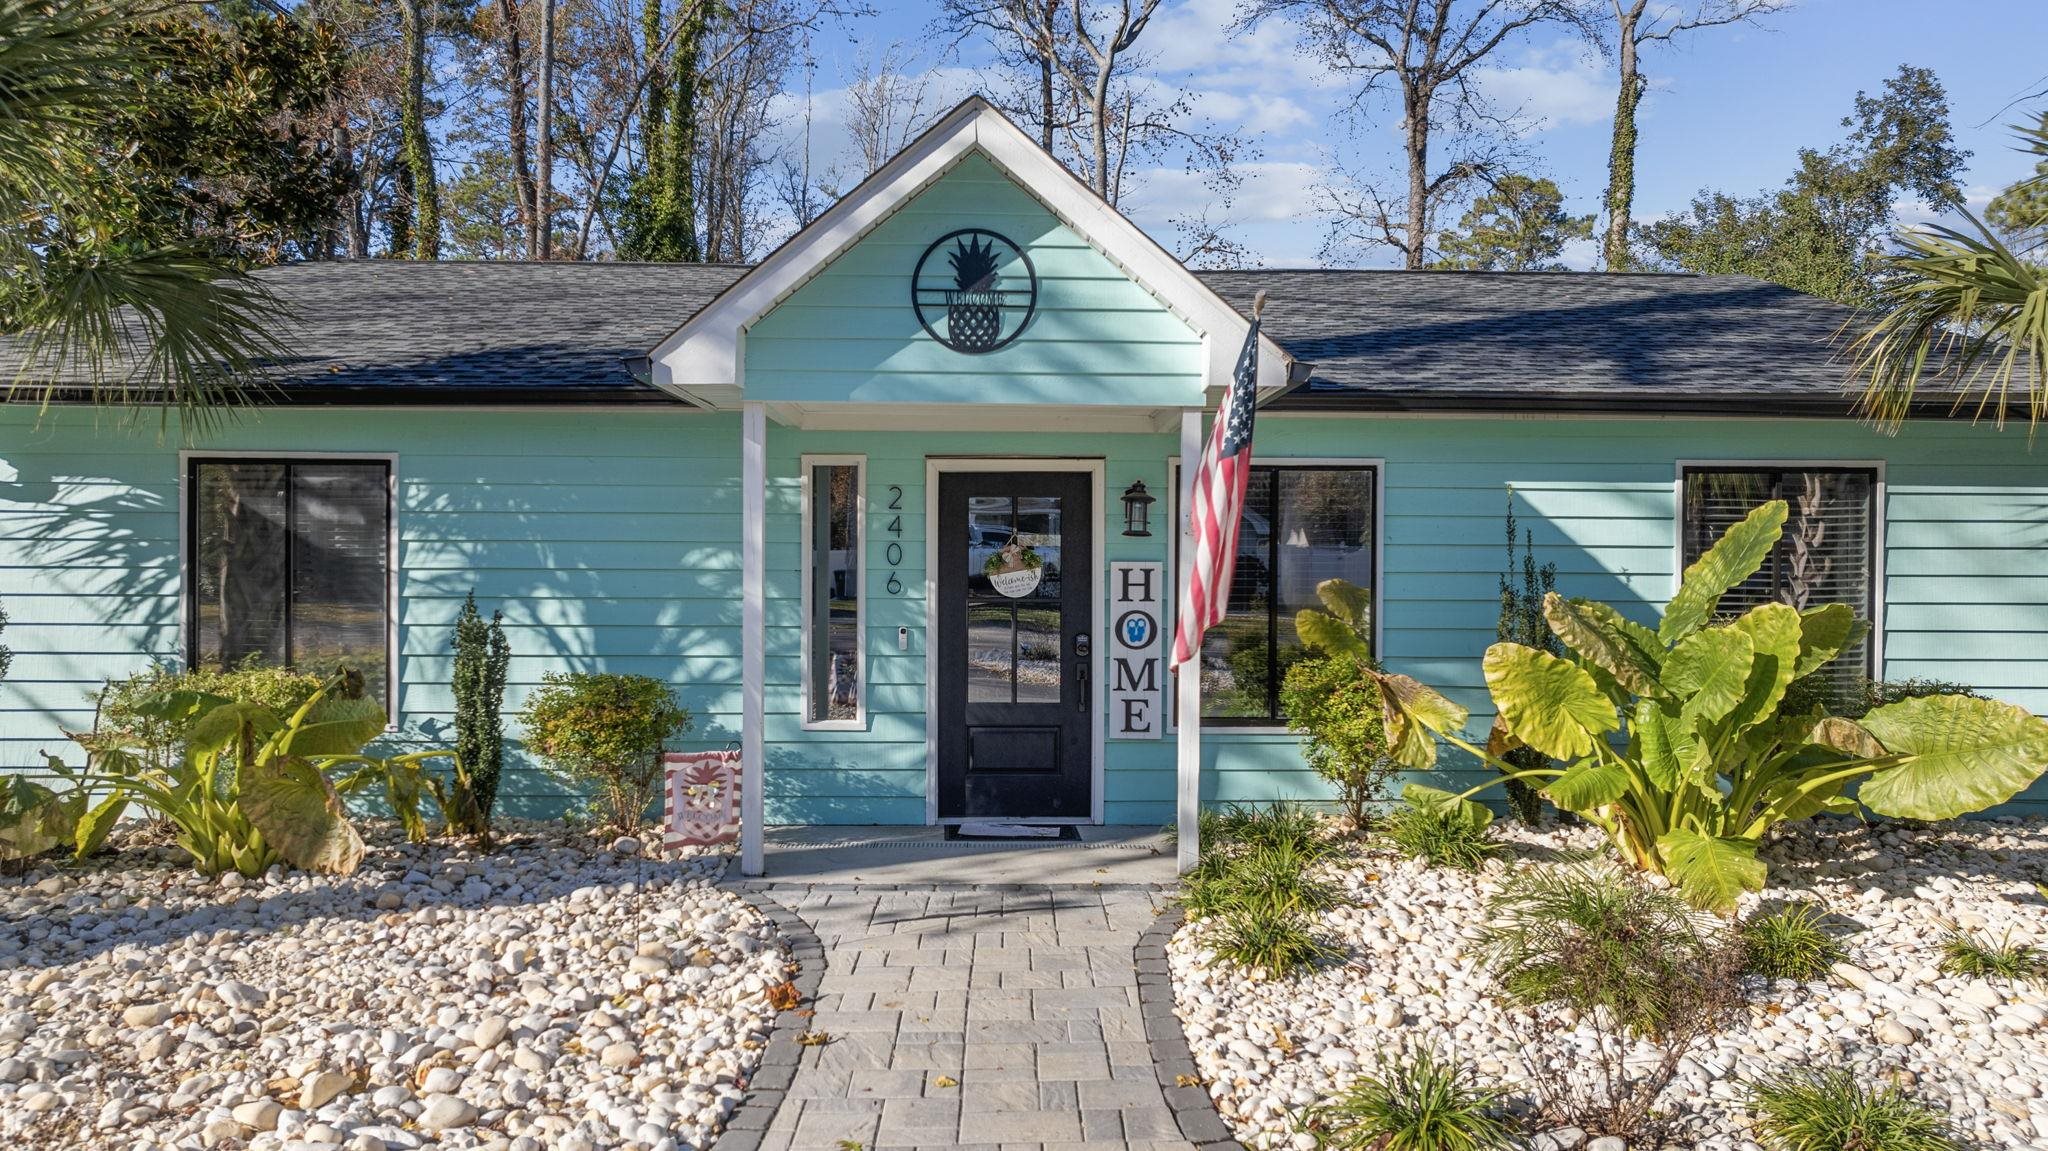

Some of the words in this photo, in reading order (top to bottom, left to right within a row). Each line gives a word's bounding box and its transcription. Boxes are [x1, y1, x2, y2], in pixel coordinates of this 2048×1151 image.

[945, 290, 1003, 305] WELCOME
[887, 486, 902, 595] 2406
[1113, 568, 1159, 732] HOME
